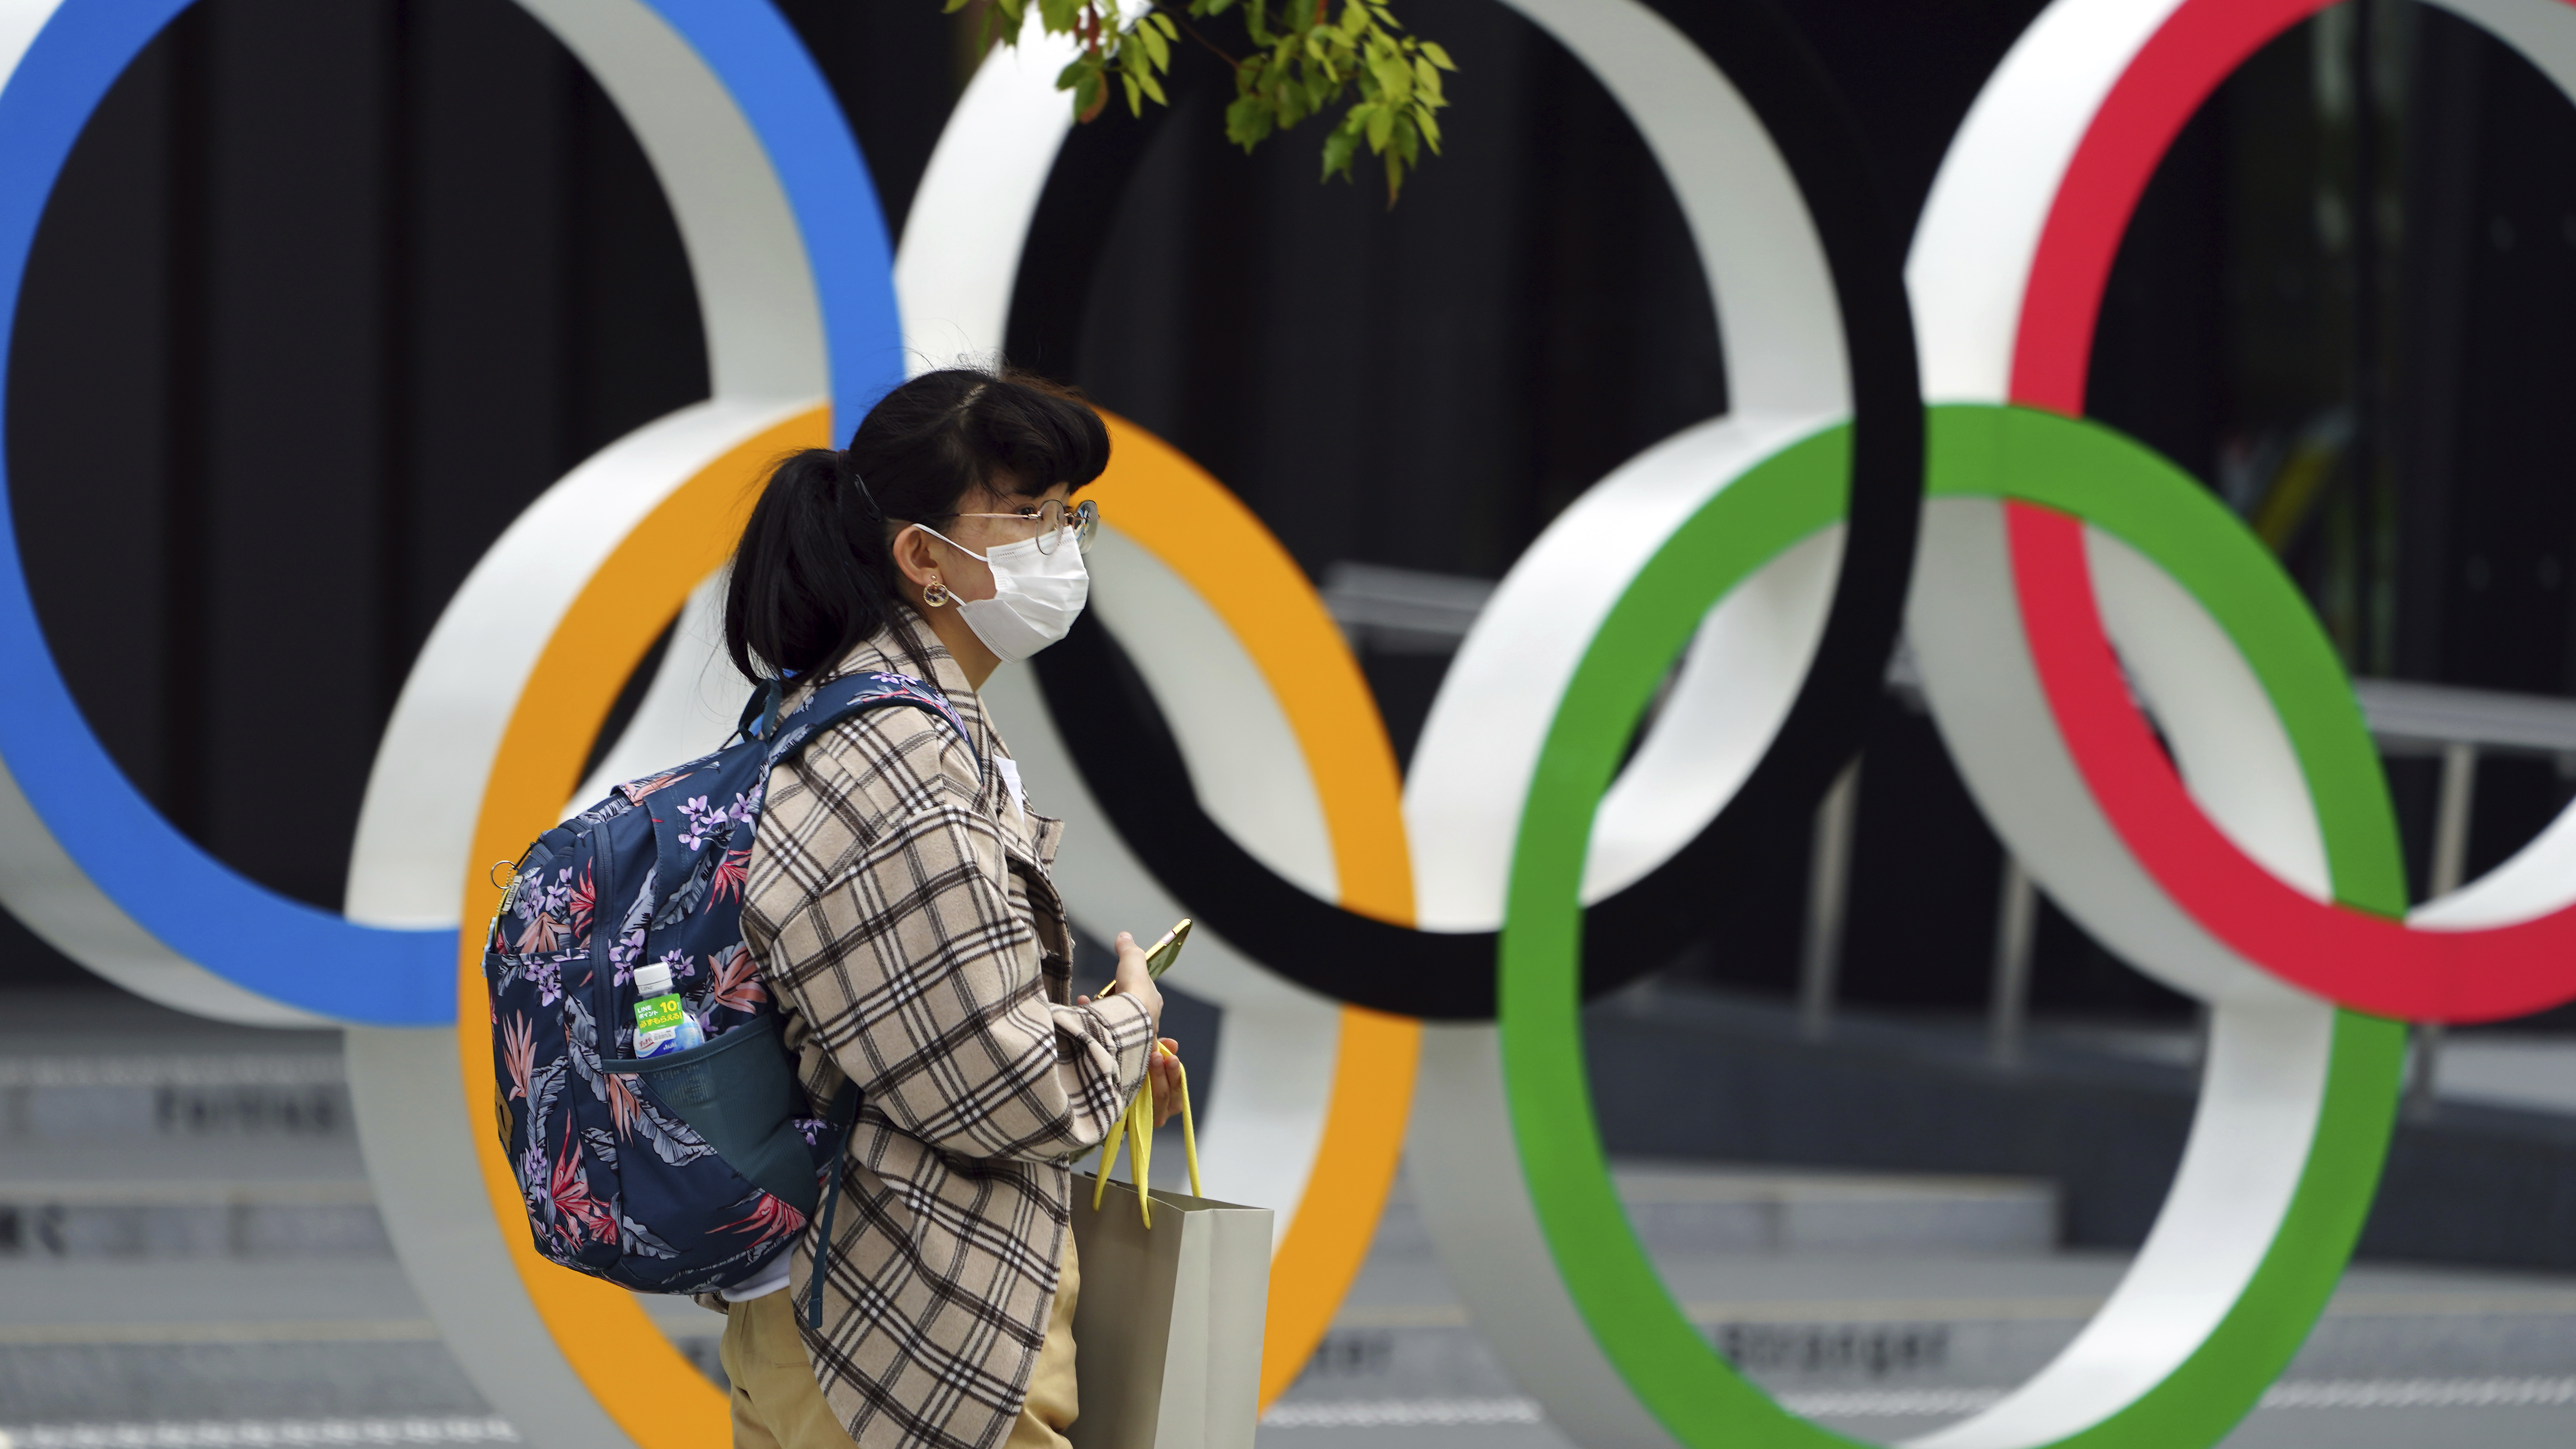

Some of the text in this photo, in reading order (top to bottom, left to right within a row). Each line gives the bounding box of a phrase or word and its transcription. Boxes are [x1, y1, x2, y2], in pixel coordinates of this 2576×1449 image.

[637, 1005, 652, 1014] LINE
[660, 1000, 677, 1013] 10
[638, 1010, 658, 1019] ポイント
